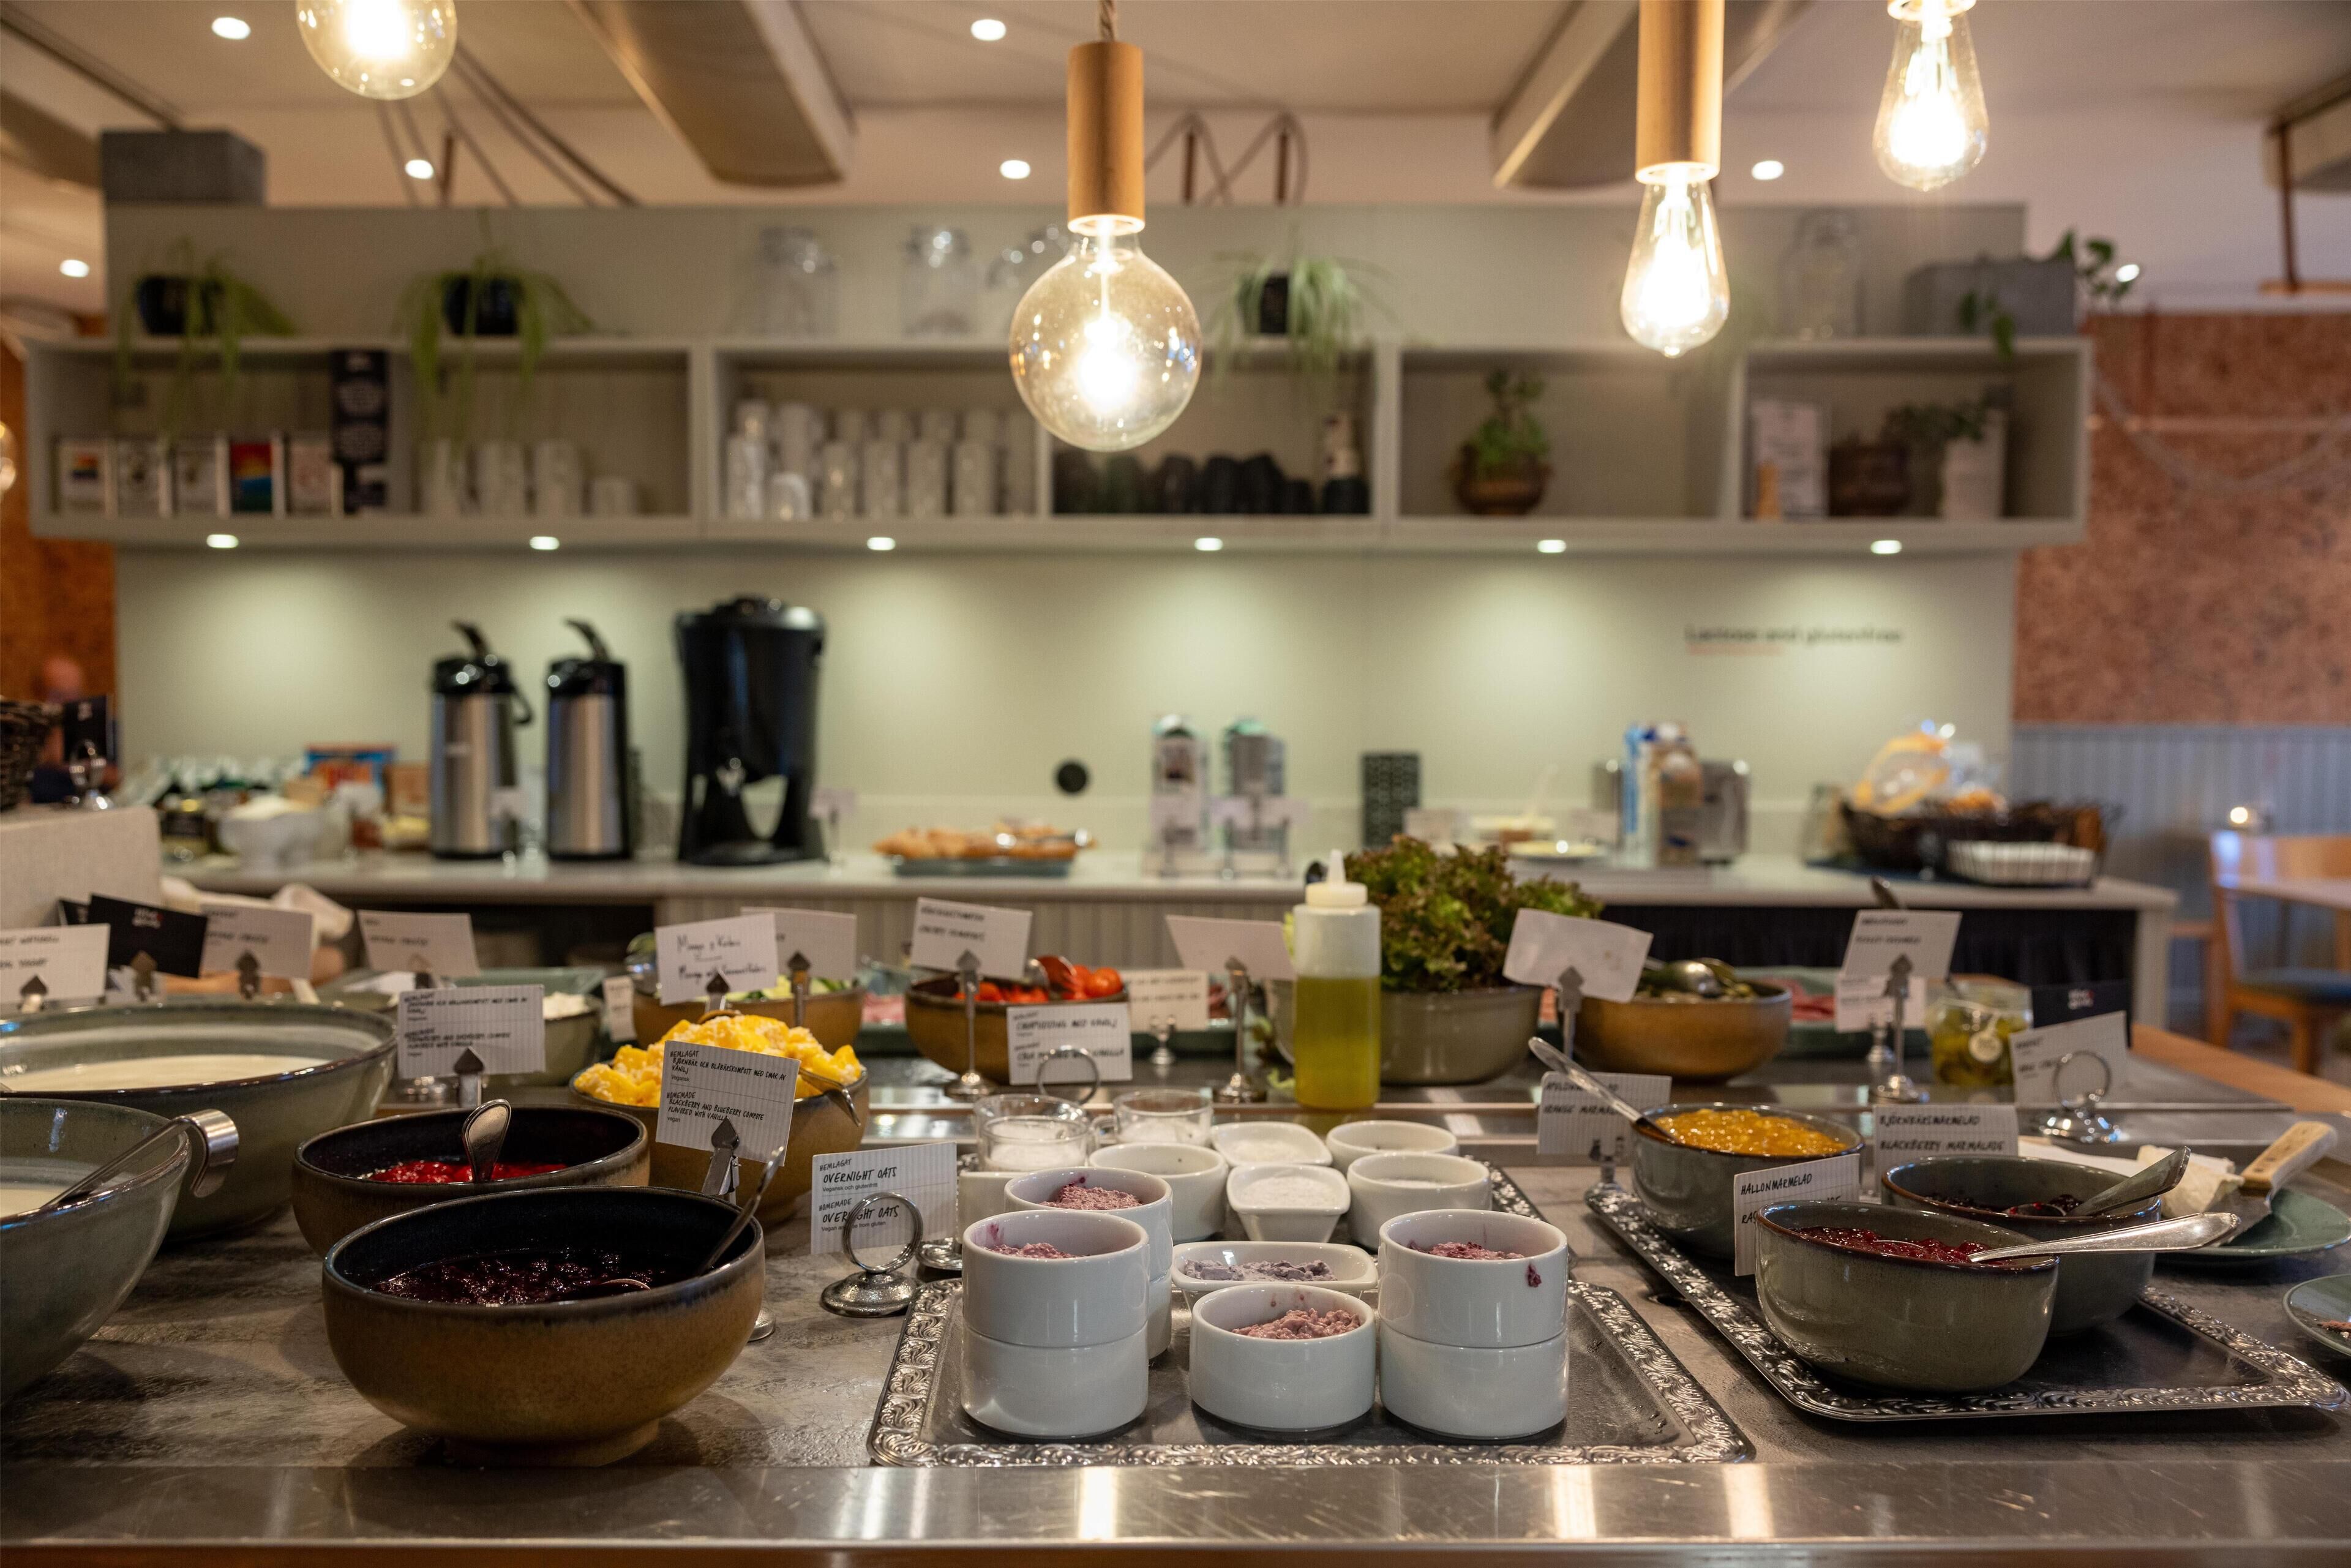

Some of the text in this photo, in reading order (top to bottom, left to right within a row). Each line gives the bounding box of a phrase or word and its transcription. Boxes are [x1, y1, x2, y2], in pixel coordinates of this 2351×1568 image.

[672, 1065, 689, 1074] VANILJ
[700, 1060, 710, 1069] OCH
[753, 1068, 764, 1077] MED
[765, 1071, 778, 1080] SMAK
[668, 1106, 694, 1117] FLAVORED
[669, 1099, 765, 1122] BLACKBERRY AND BLUEBERRY COMPOTE
[1880, 1139, 2006, 1152] BLACKBERRY MARMALADE
[819, 1158, 852, 1172] HEMLAGAT
[823, 1166, 898, 1184] OVERNIGHT OATS
[1741, 1173, 1813, 1196] HALLONMARMELAD
[819, 1198, 852, 1212] HOMEMADE
[878, 1205, 900, 1218] OATS
